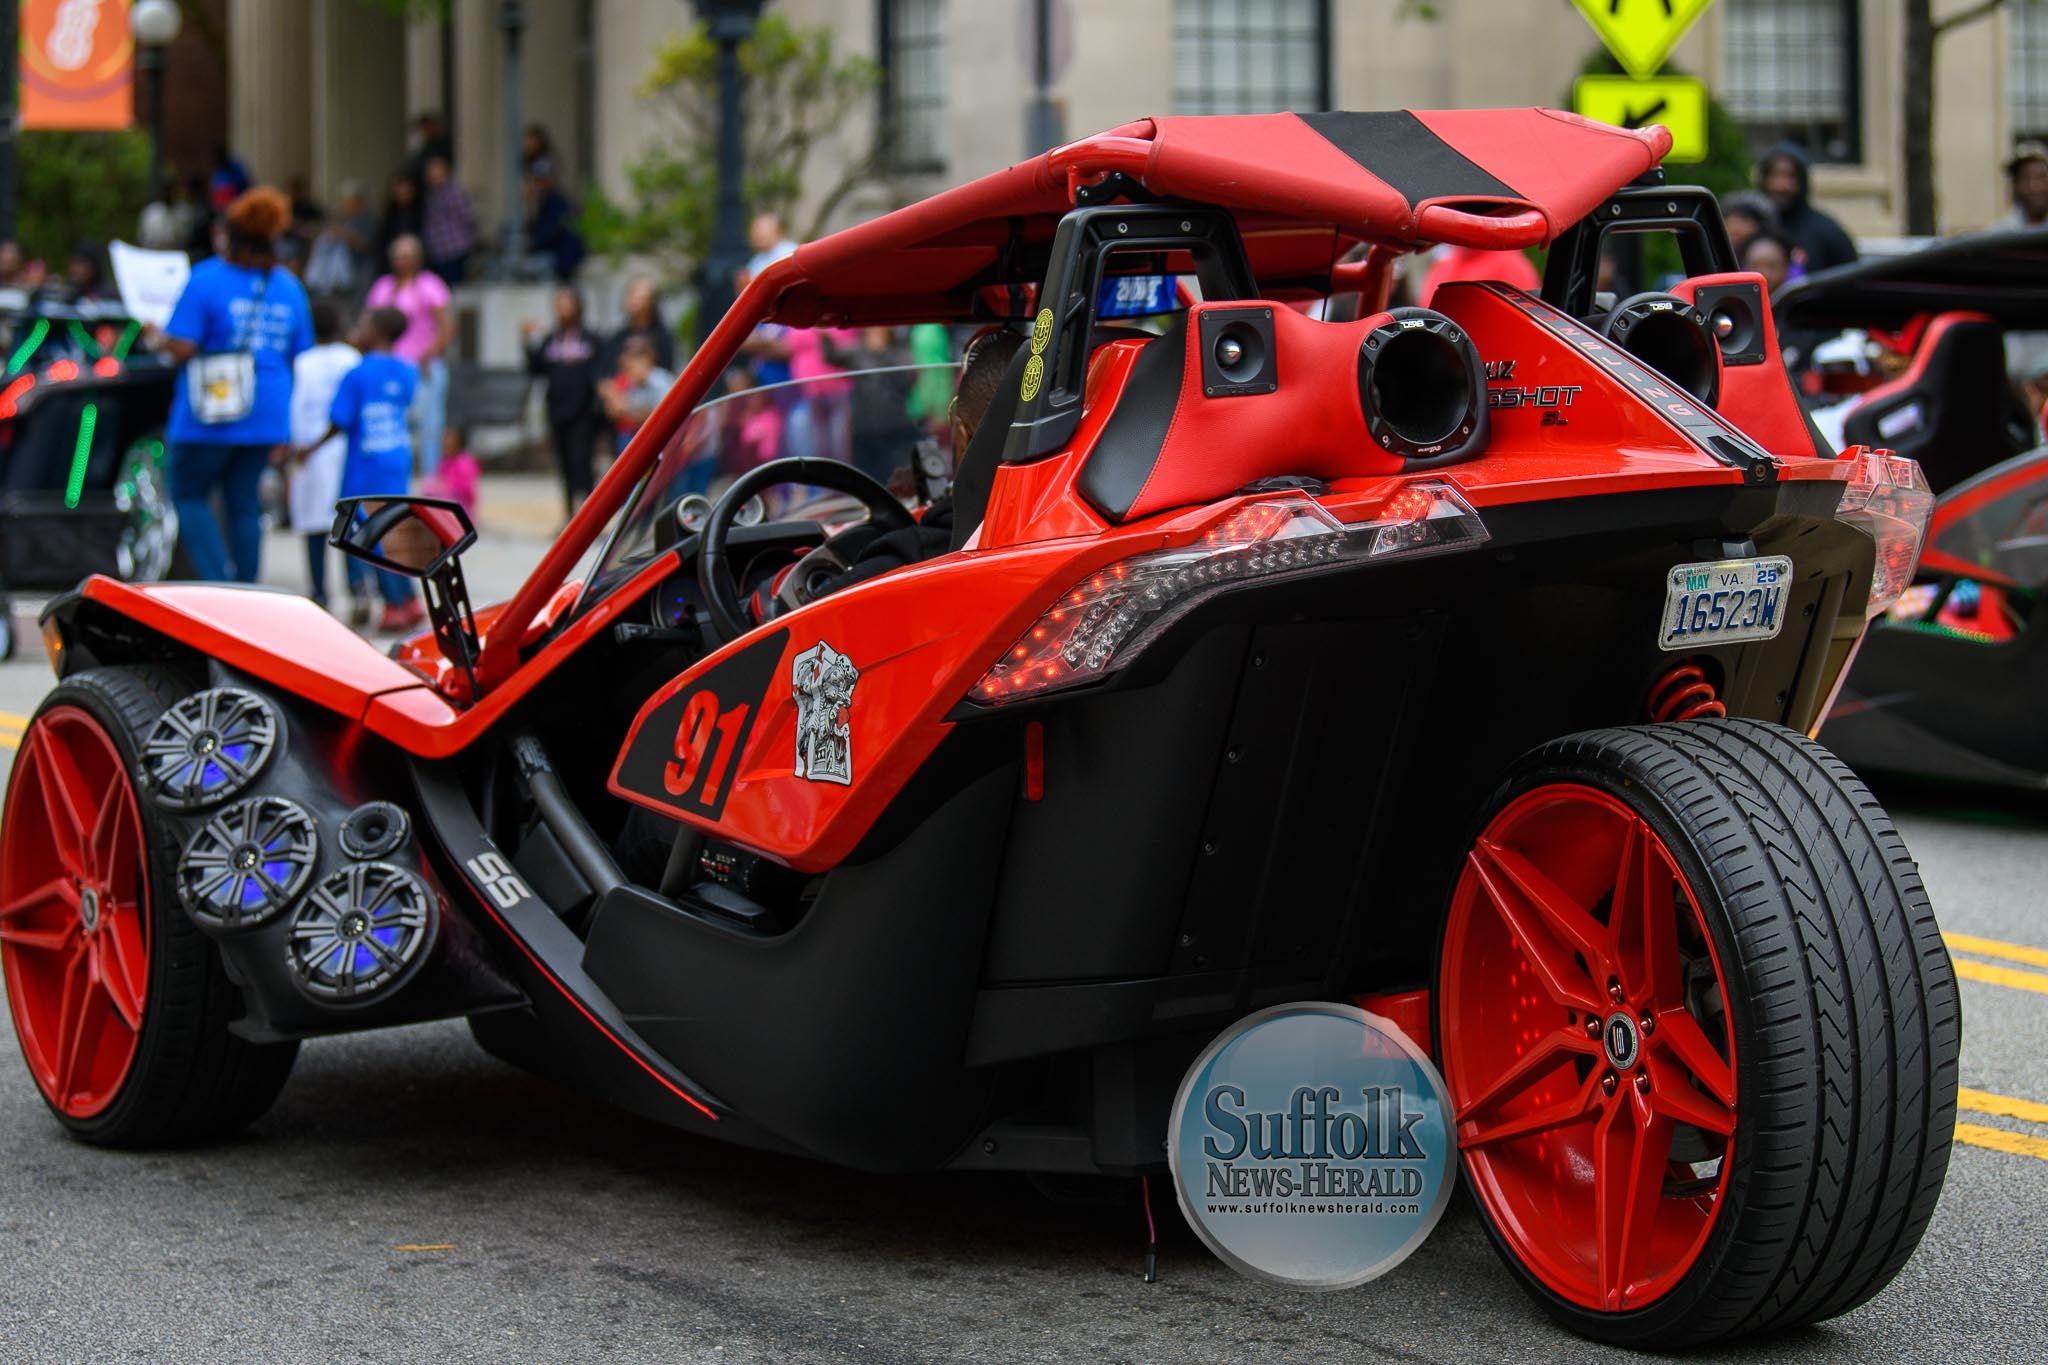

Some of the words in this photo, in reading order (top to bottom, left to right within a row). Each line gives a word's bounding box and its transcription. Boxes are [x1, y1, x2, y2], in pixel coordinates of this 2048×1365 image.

[1485, 360, 1517, 380] UZ
[1488, 385, 1582, 408] GSHOT
[1686, 574, 1710, 592] MAY
[1720, 573, 1744, 587] VA.
[1757, 569, 1777, 584] 25
[1672, 586, 1781, 635] 16523W
[664, 690, 749, 806] 91
[467, 851, 532, 909] SS
